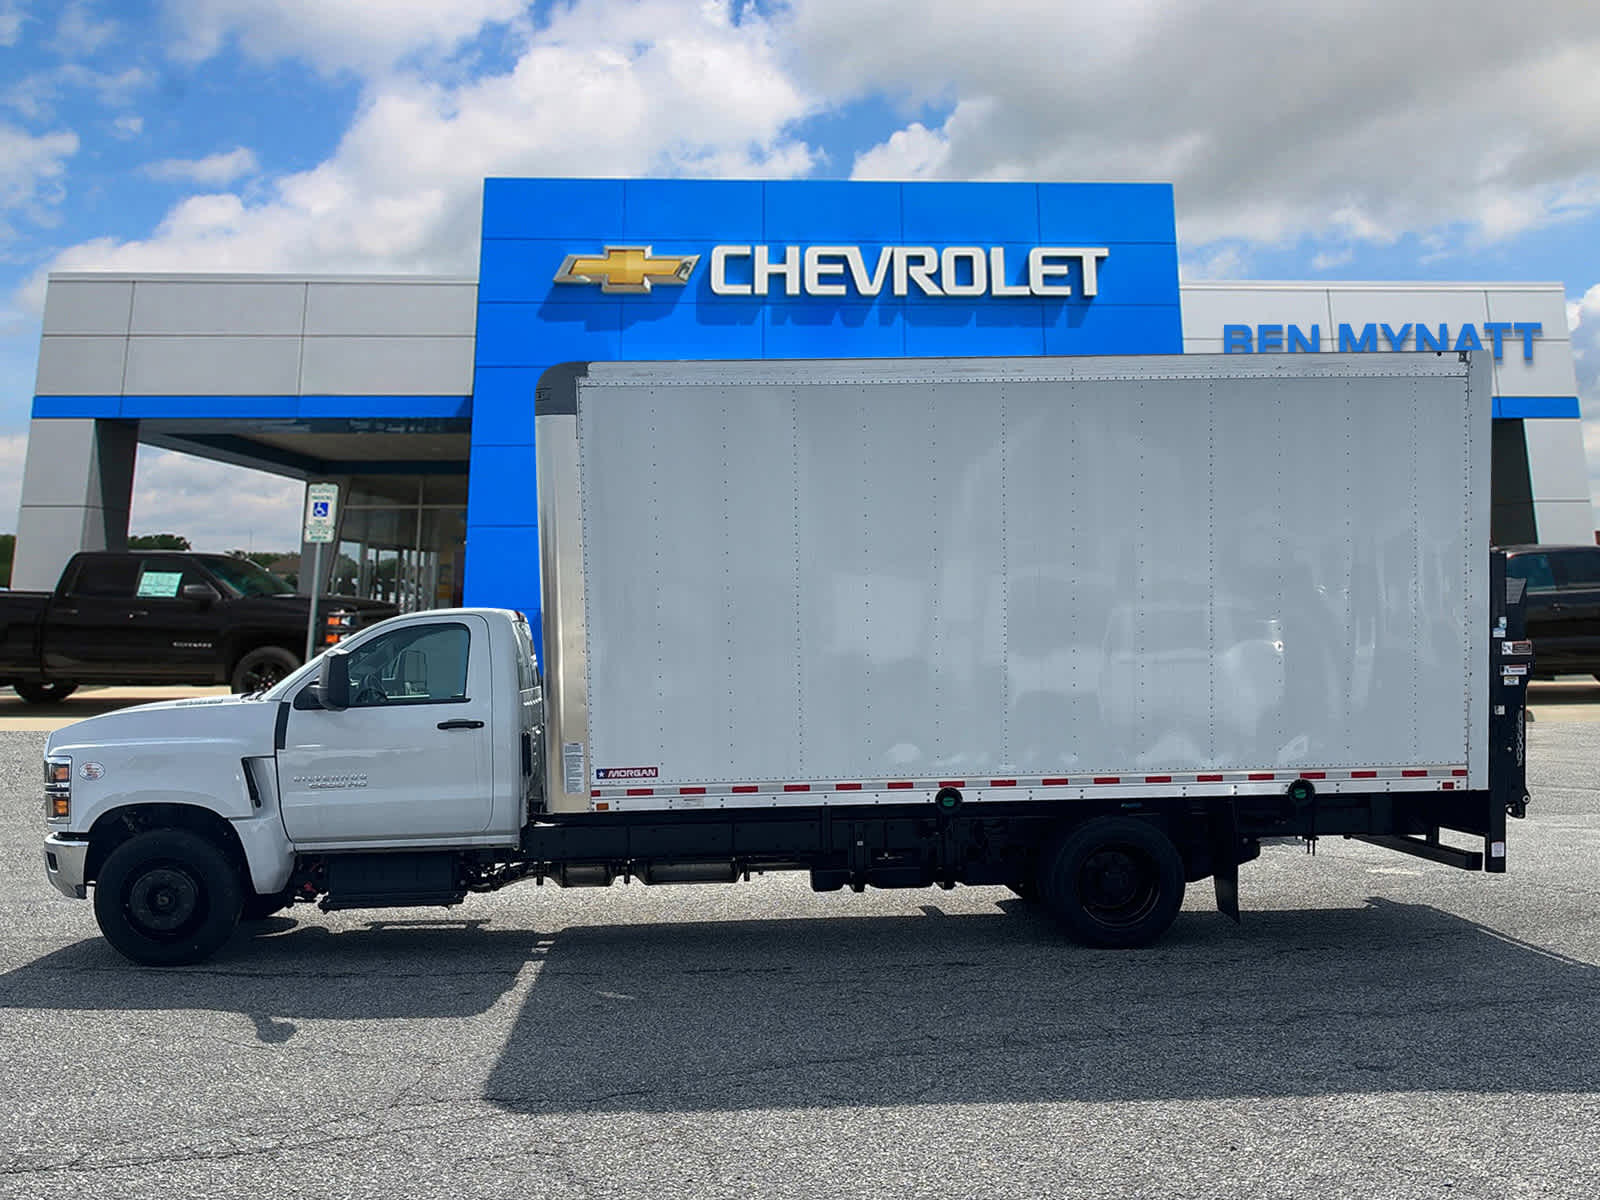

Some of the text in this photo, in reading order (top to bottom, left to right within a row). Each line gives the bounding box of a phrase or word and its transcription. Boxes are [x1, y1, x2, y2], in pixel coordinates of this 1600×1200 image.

[710, 244, 1110, 297] CHEVROLET
[1223, 321, 1543, 361] BEN MYNATT
[607, 768, 657, 778] MORGAN
